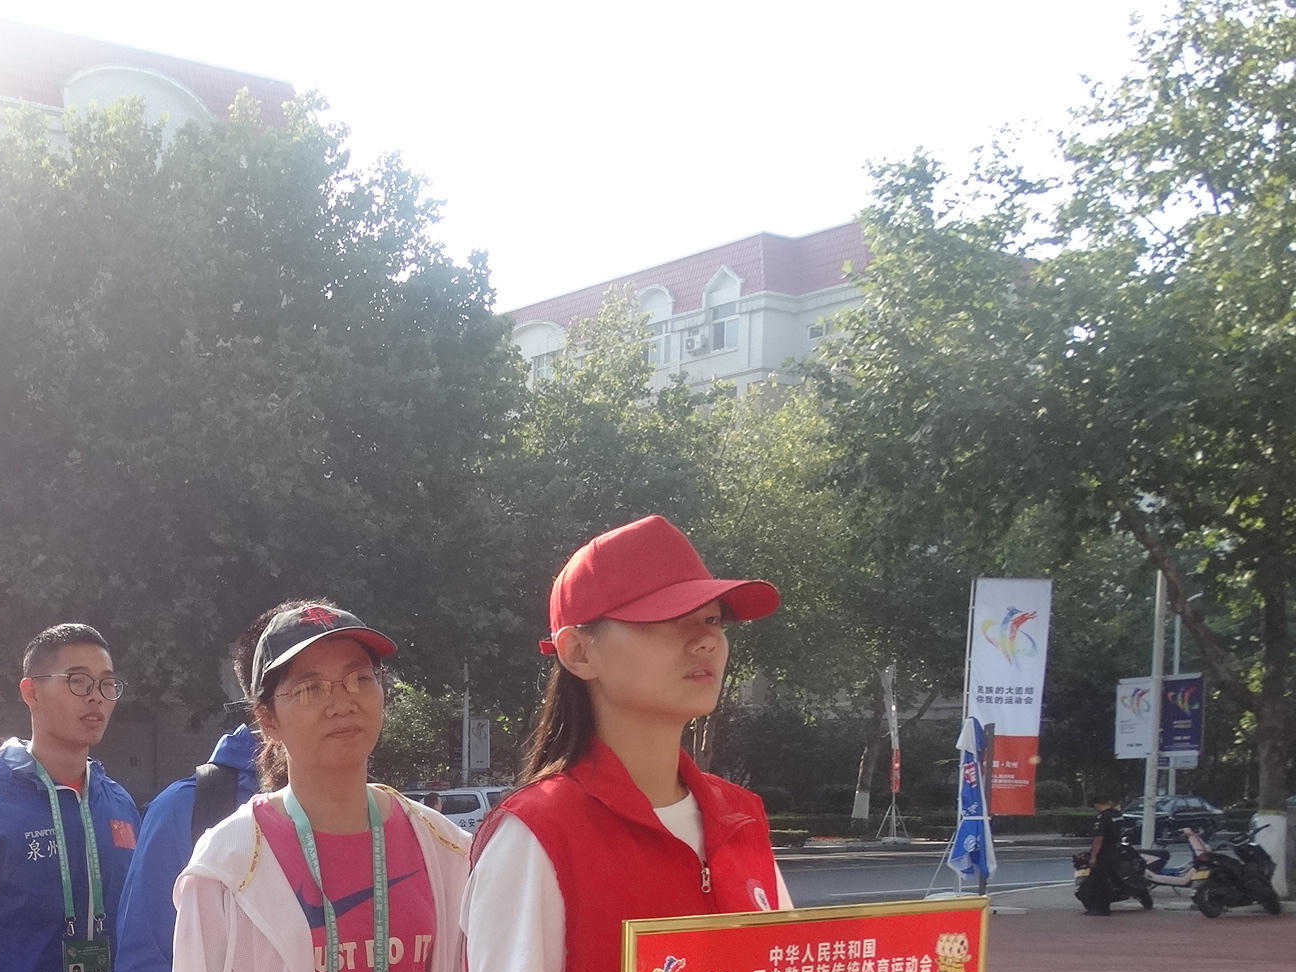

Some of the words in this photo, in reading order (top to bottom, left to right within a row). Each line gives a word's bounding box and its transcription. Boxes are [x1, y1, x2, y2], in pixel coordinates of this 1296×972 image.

[459, 818, 475, 828] 公安
[27, 839, 58, 861] 泉州
[769, 938, 876, 967] 中华人民共和国
